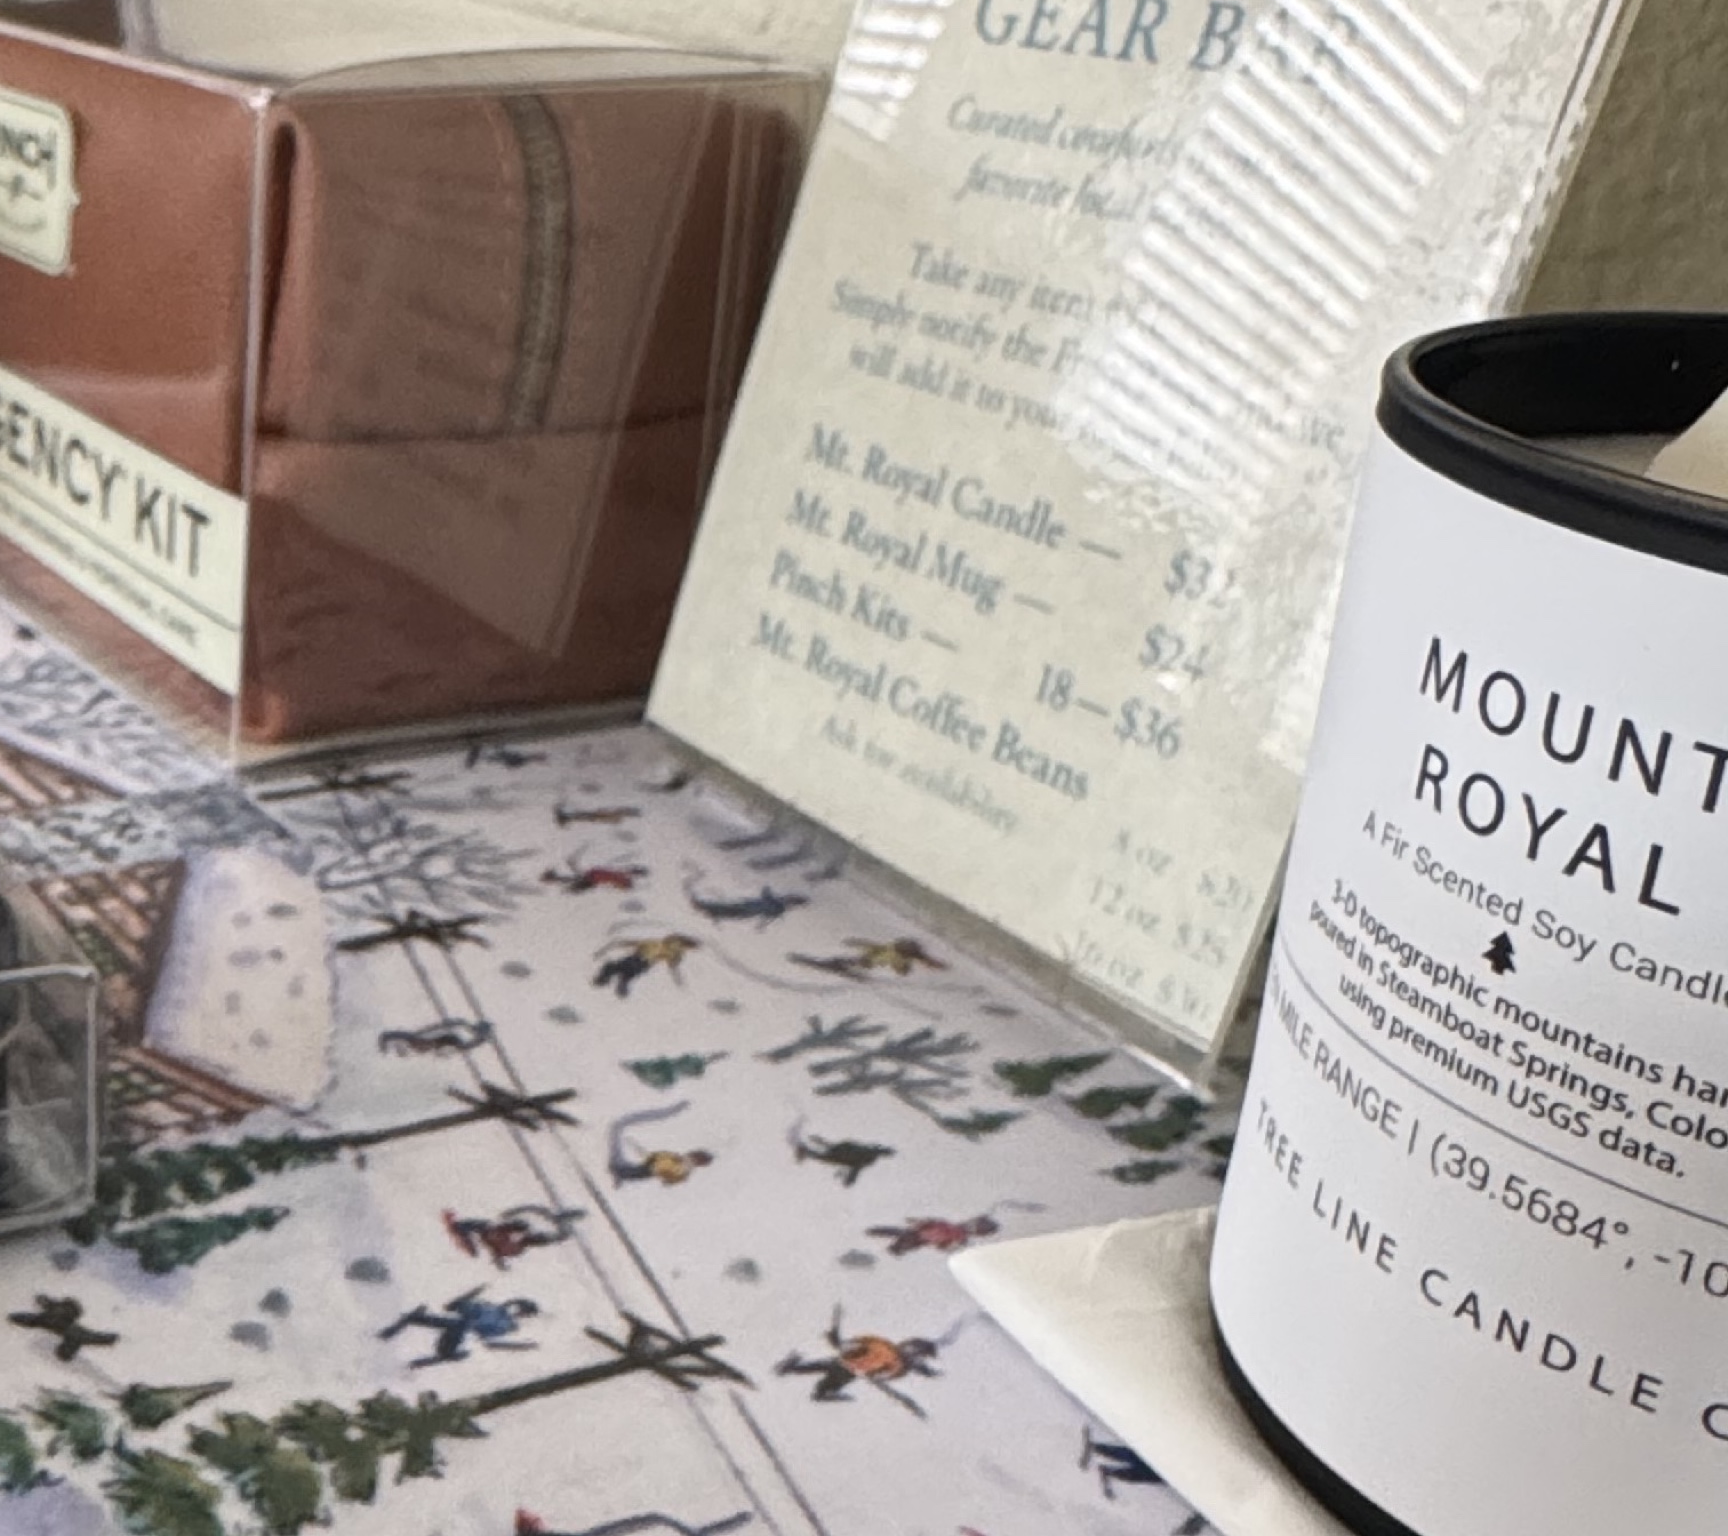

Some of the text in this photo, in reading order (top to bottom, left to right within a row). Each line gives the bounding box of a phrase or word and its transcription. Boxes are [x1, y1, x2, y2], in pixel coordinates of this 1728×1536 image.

[134, 471, 212, 580] KIT
[786, 489, 832, 539] Mt.
[840, 508, 928, 571] Royal
[925, 543, 1003, 616] Mug
[810, 421, 853, 475] Mt.
[861, 441, 950, 507] Royal
[951, 475, 1069, 551] Candle
[769, 548, 848, 612] Pinch
[850, 583, 910, 642] Kits
[752, 612, 1090, 802] Mt. Royal Coffee Beans
[1418, 636, 1728, 814] MOUNT
[1362, 809, 1728, 1010] A Fir Scented Soy Candl
[1414, 742, 1681, 917] ROYAL
[1338, 973, 1387, 1031] using
[1387, 1013, 1500, 1098] premium
[1506, 1077, 1592, 1140] USGS
[1597, 1114, 1686, 1180] data.
[1358, 905, 1490, 1009] topographic
[1493, 994, 1664, 1086] mountains
[1358, 942, 1374, 977] in
[1375, 959, 1505, 1058] Steamboat
[1506, 1040, 1635, 1121] Springs,
[1313, 1037, 1404, 1140] RANGE
[1256, 1097, 1304, 1191] TREE
[1312, 1176, 1400, 1275] LINE
[1419, 1267, 1663, 1414] CANDLE
